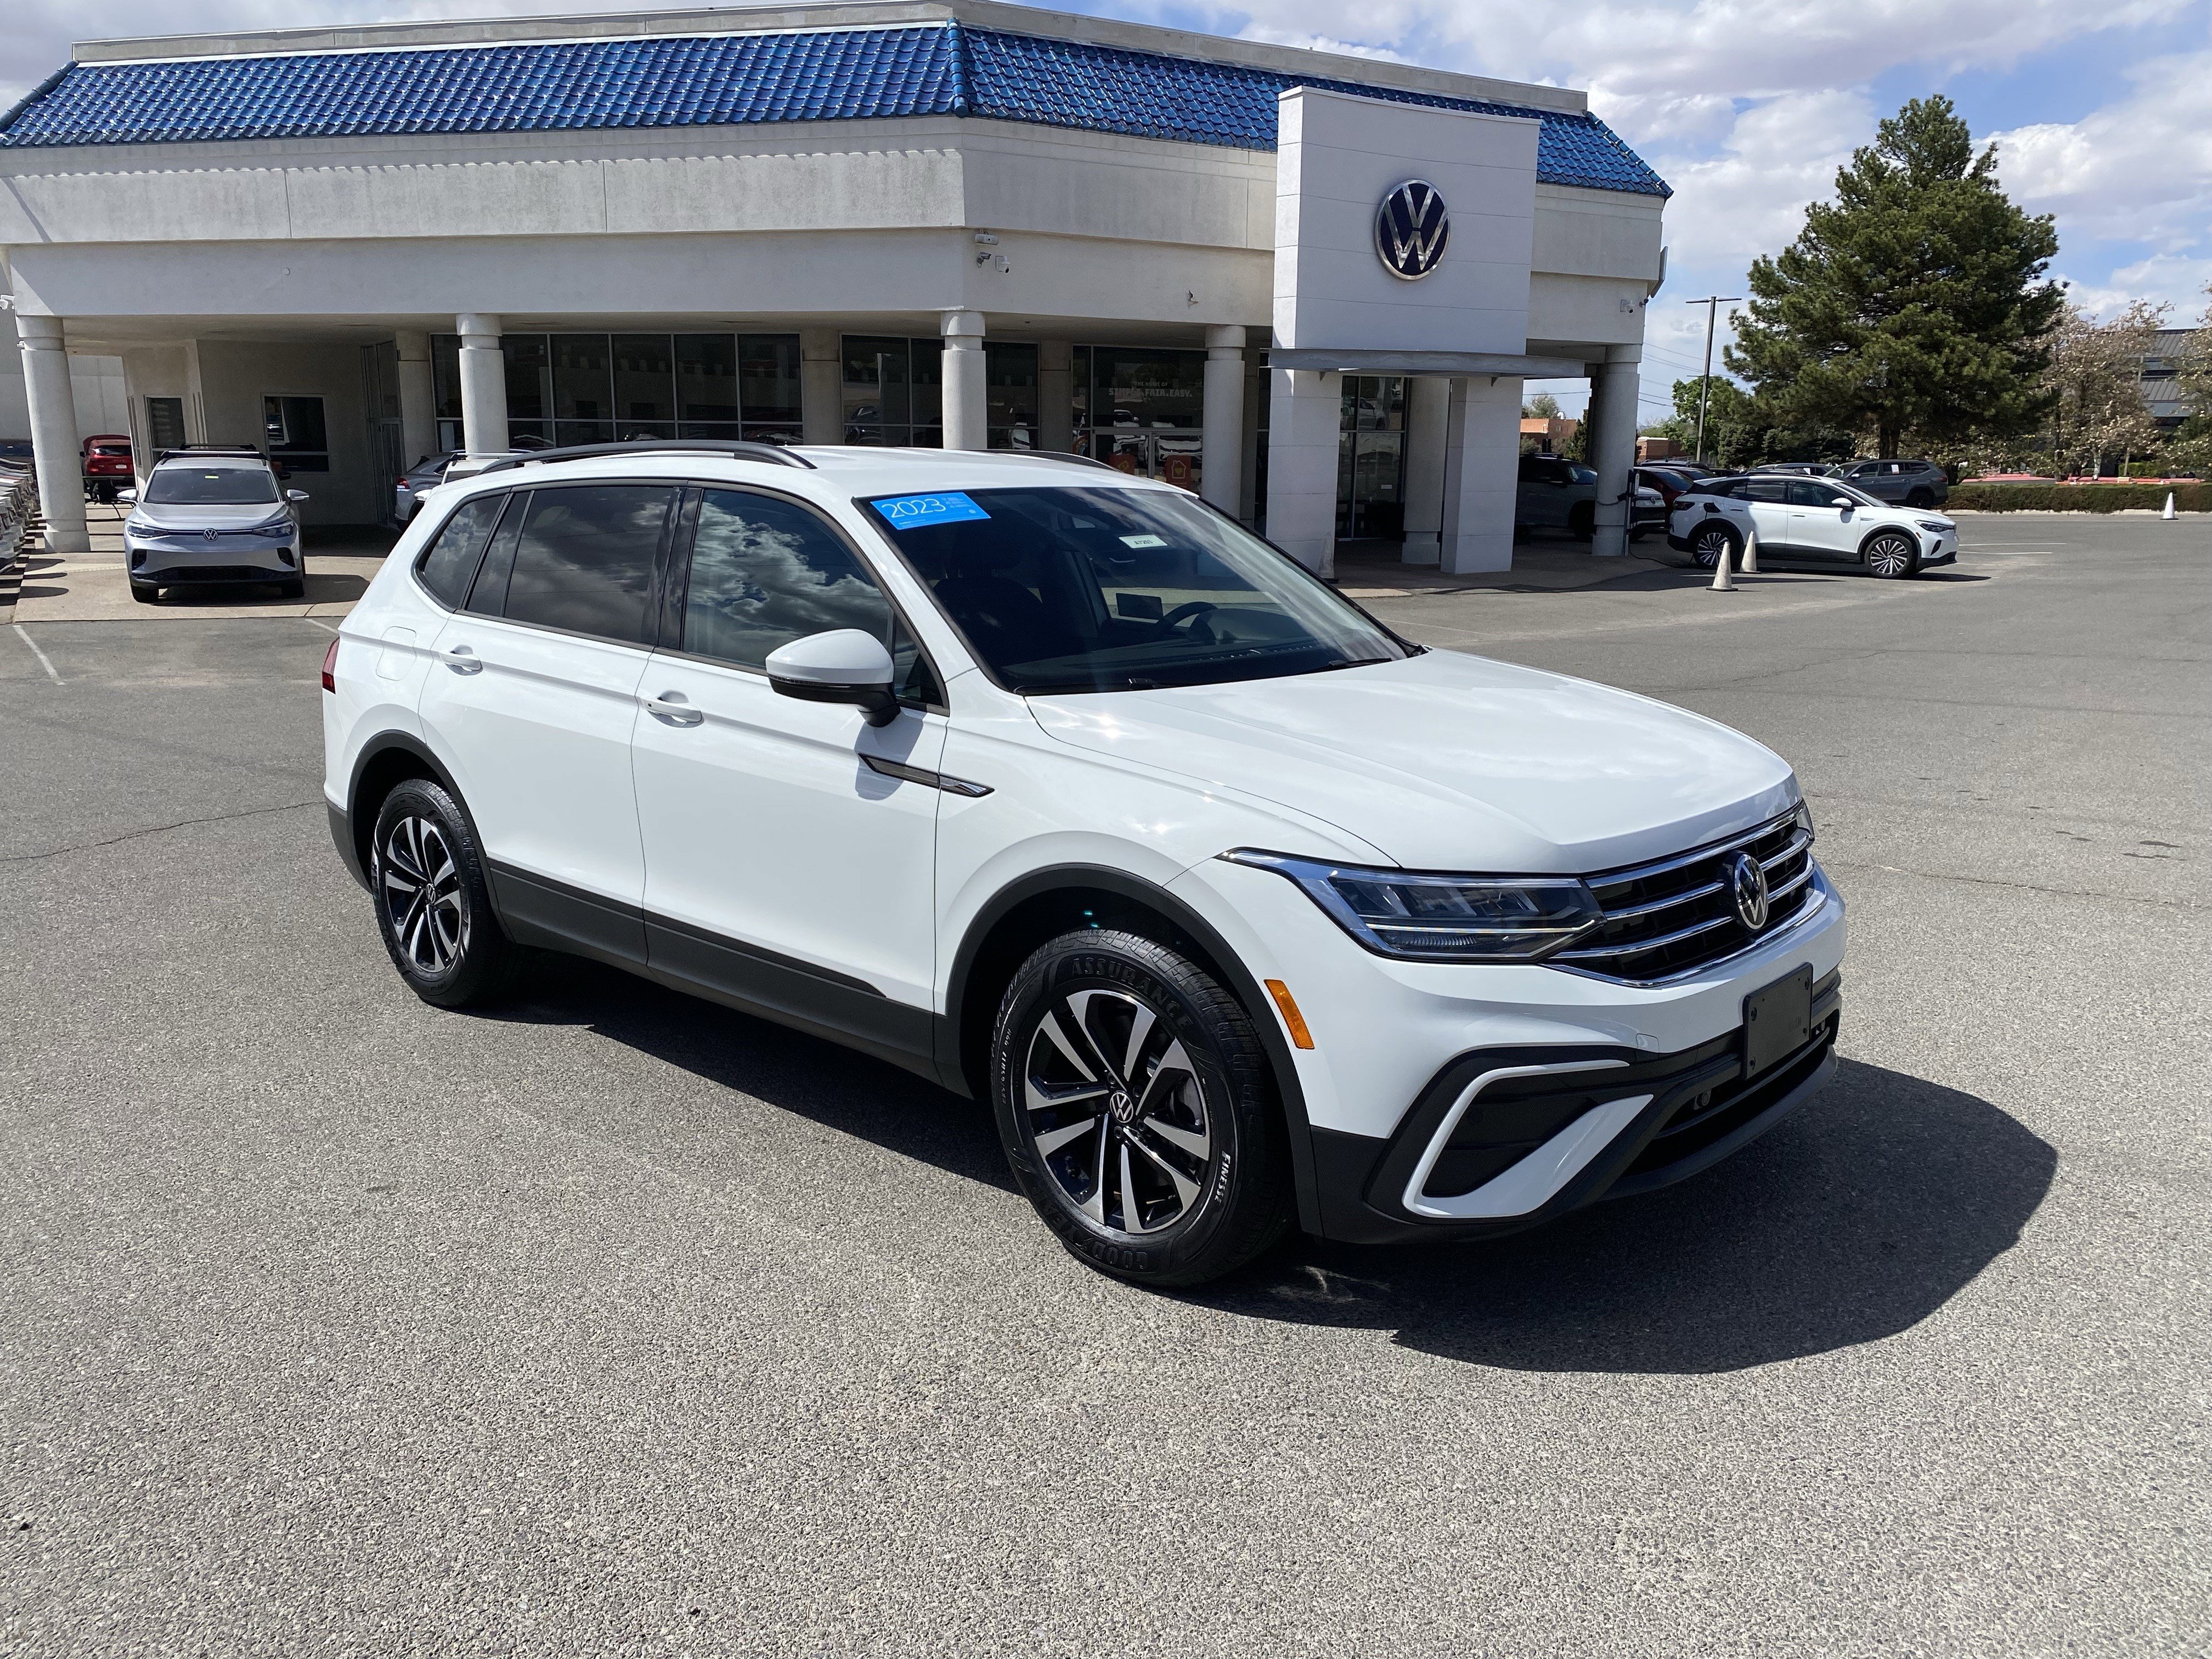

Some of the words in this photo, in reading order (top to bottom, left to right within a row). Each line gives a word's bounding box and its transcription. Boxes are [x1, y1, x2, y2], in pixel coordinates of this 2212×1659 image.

[881, 498, 946, 518] 2023
[1071, 957, 1194, 1030] ASSURANCE
[1214, 1150, 1231, 1205] FINESSE
